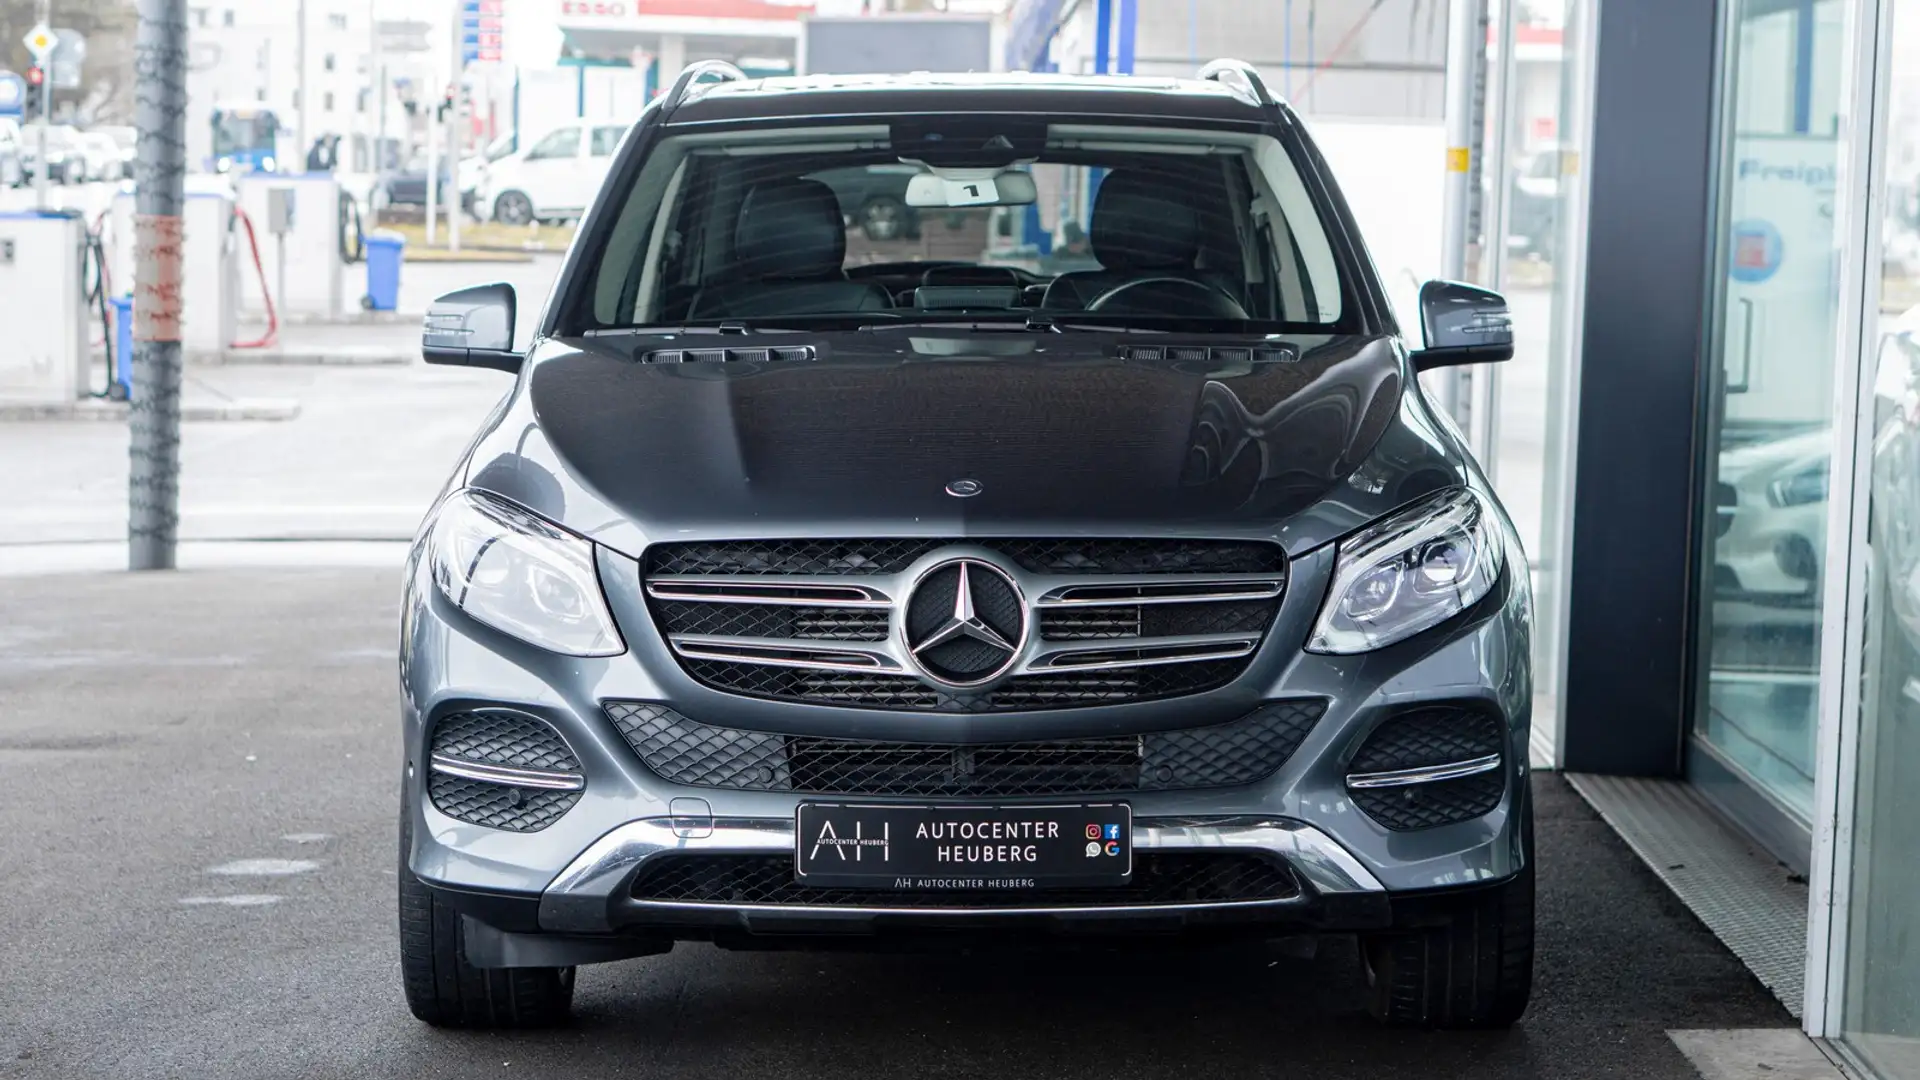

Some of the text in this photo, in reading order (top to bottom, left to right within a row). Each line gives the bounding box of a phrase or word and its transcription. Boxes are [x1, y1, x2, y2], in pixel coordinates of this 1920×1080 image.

[963, 184, 980, 197] 1
[915, 821, 1059, 839] AUTOCENTER
[809, 820, 889, 862] AH
[816, 838, 858, 846] AUTOCENTER
[938, 844, 1037, 862] HEUBERG
[894, 877, 1035, 889] AH AUTOCENTER HEUBERG
